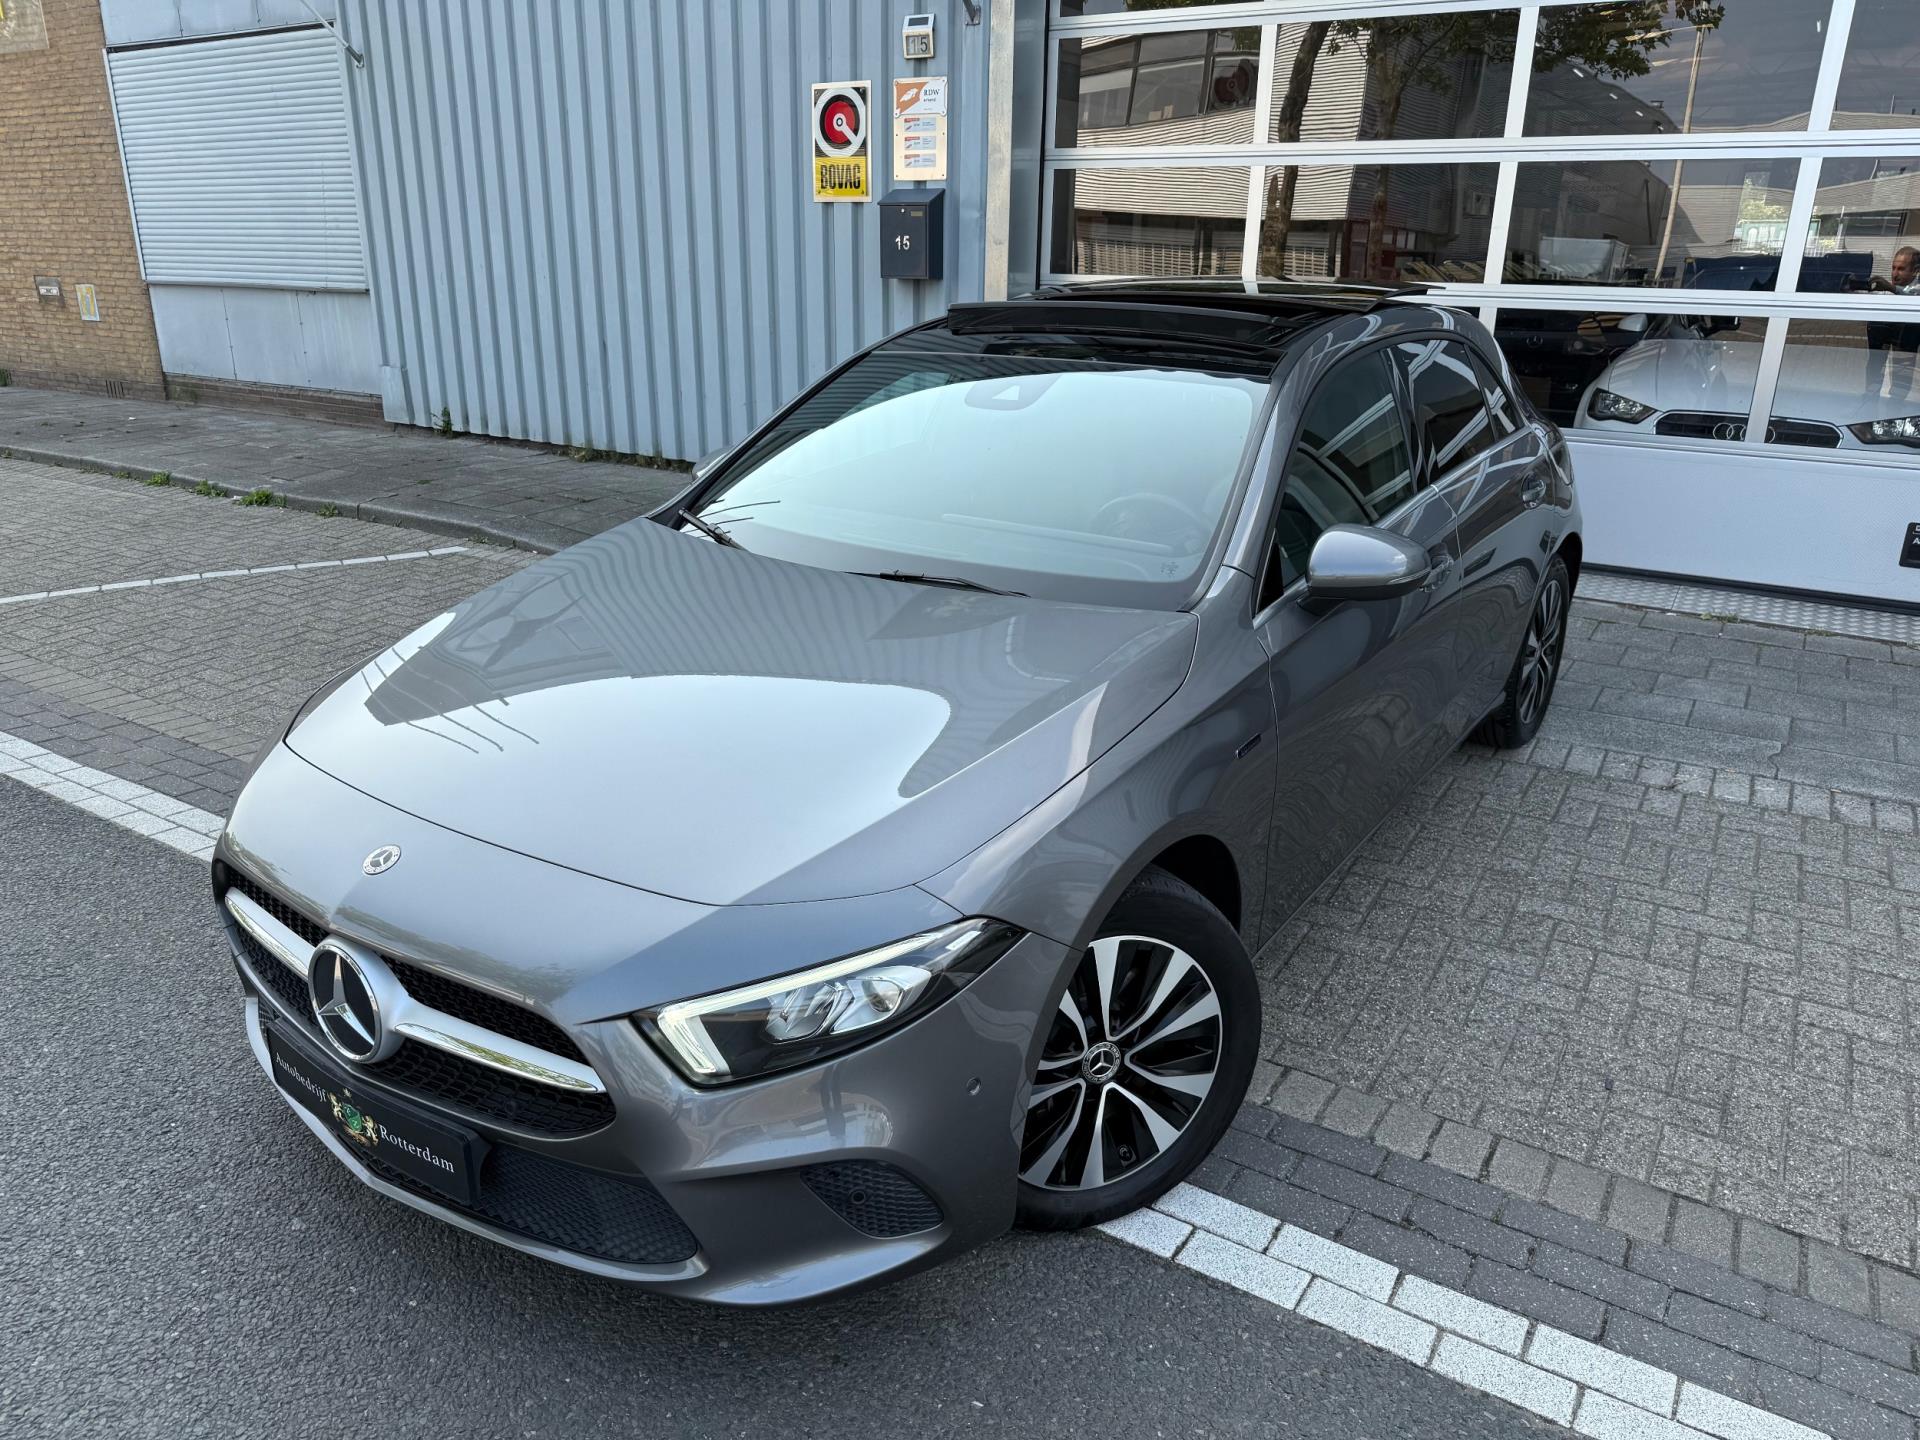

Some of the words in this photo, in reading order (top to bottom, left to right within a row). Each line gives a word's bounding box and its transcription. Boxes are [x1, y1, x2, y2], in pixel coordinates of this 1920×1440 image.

[911, 36, 928, 53] 15
[820, 163, 861, 190] BOVAG
[895, 235, 910, 251] 15
[275, 1052, 328, 1104] Autobedrijf
[379, 1124, 455, 1174] Rotterdam
